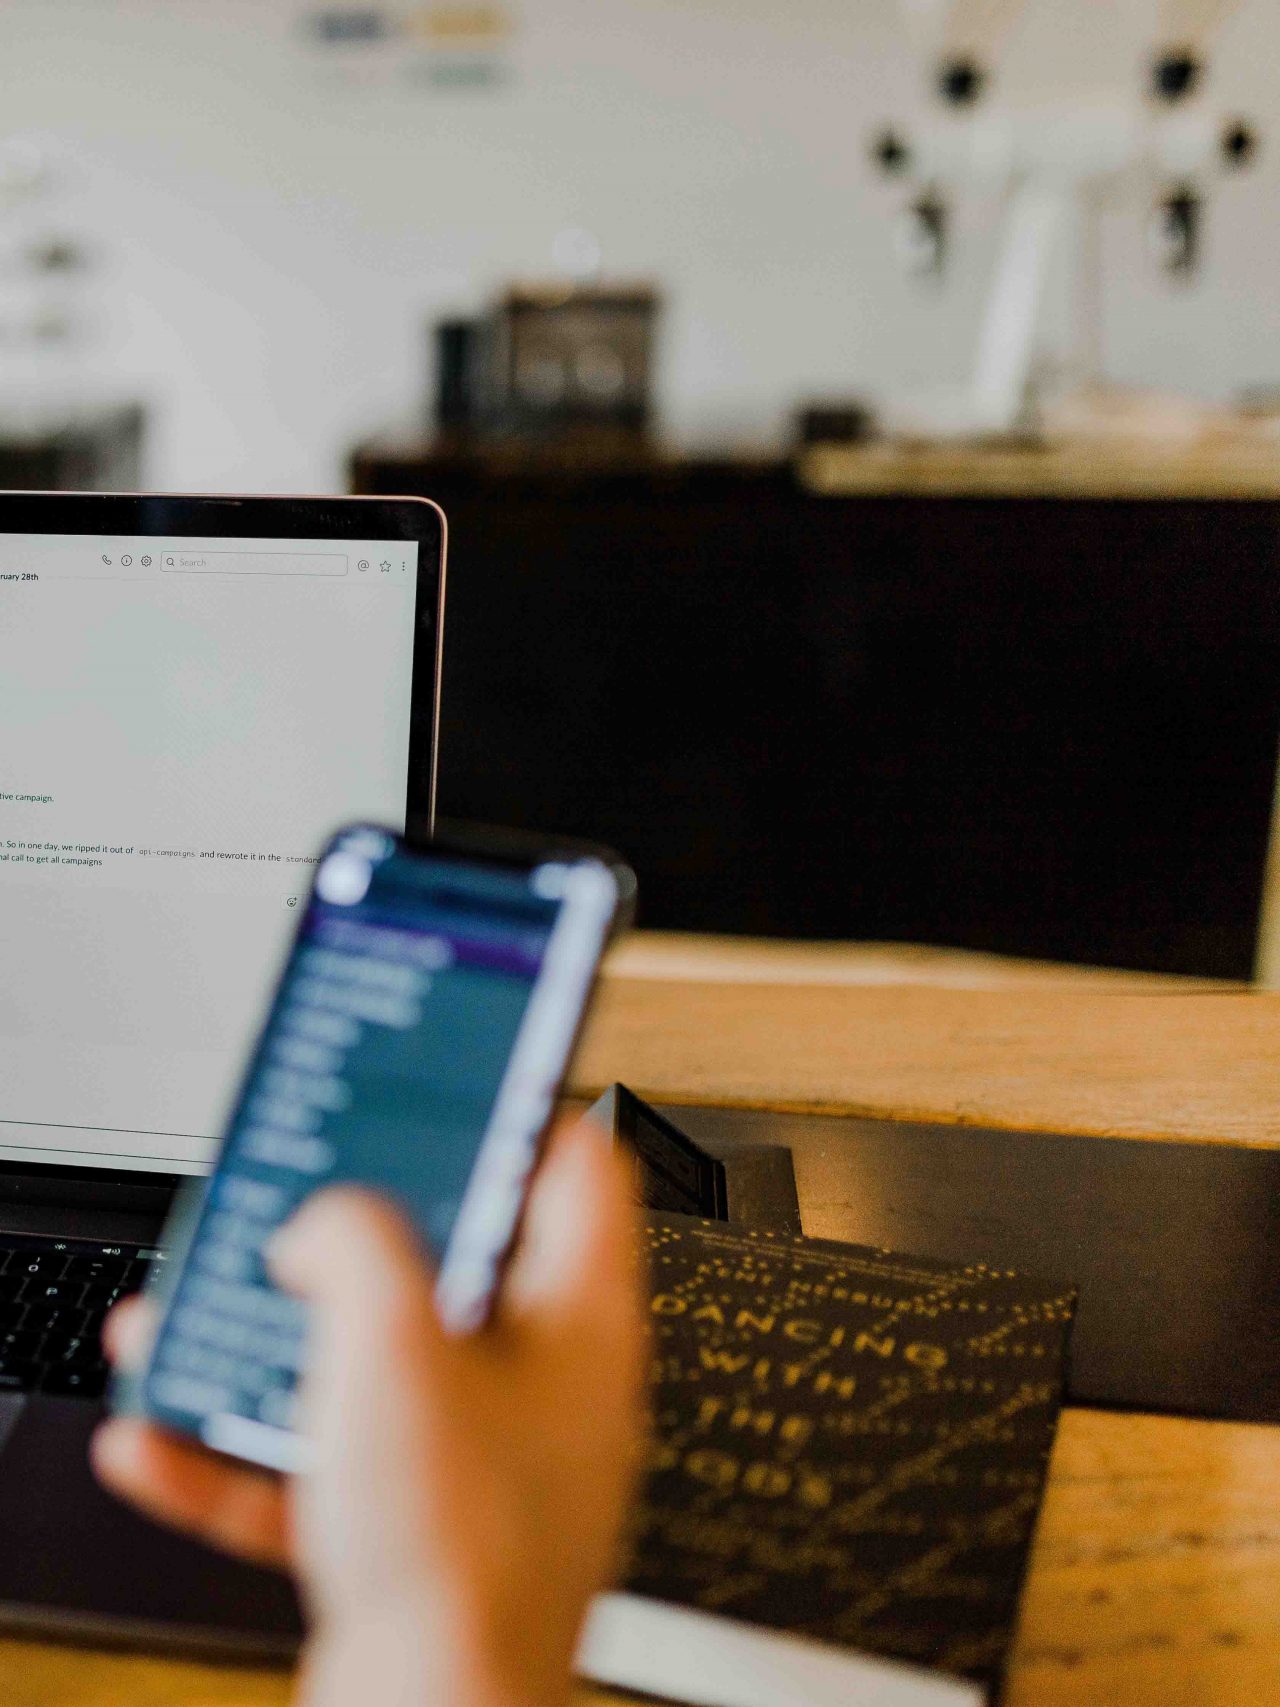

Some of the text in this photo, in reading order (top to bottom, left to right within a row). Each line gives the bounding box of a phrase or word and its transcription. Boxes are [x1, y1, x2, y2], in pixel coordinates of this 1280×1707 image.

[180, 558, 206, 567] Search
[22, 573, 38, 581] 28th
[16, 795, 54, 803] campaign.
[7, 840, 16, 848] So
[19, 841, 26, 849] in
[44, 842, 60, 851] day,
[75, 844, 100, 853] ripped
[103, 845, 107, 853] it
[110, 846, 123, 854] out
[217, 852, 248, 860] rewrote
[258, 853, 266, 861] in
[36, 856, 48, 864] get
[62, 858, 102, 867] campaigns
[651, 1294, 947, 1370] DANCING
[700, 1346, 856, 1399] WITH
